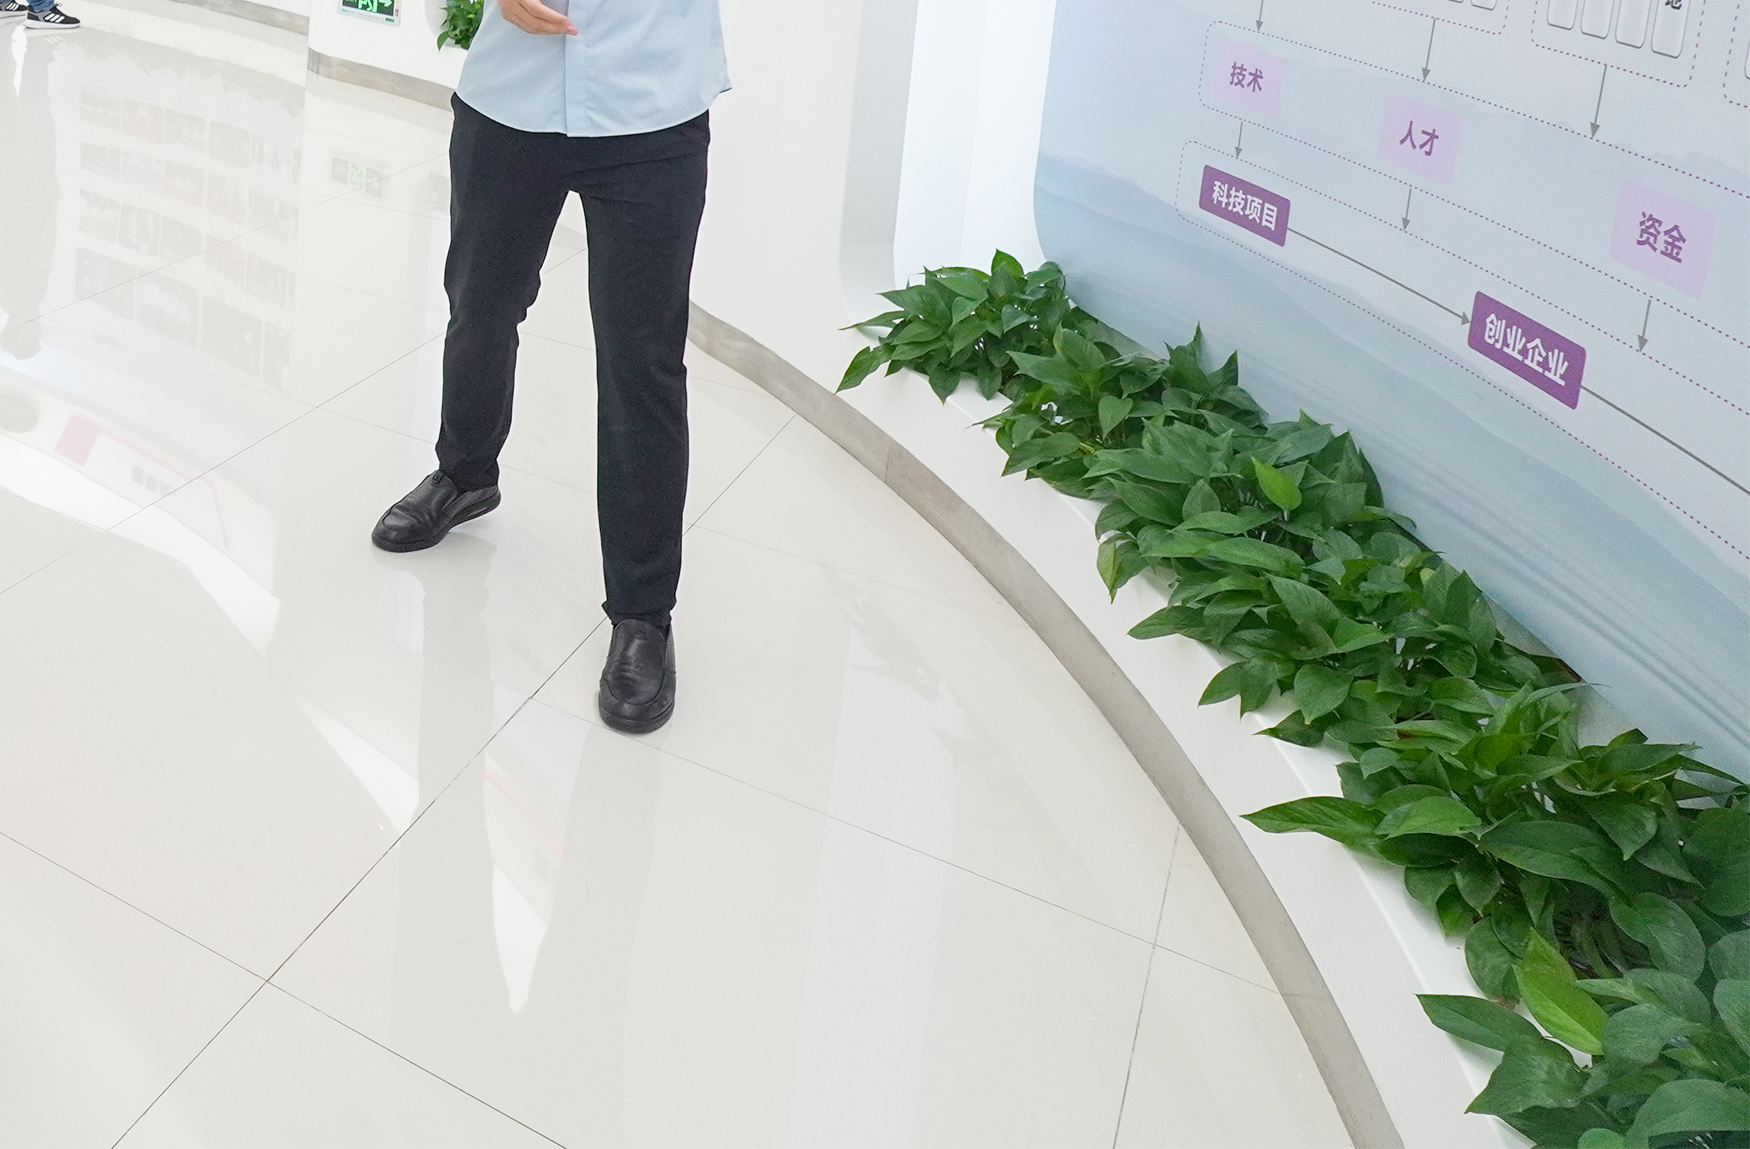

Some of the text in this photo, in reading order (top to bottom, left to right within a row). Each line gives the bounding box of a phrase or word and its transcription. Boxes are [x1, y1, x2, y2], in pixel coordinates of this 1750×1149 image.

[1229, 61, 1264, 94] 技术
[1398, 120, 1440, 158] 人才
[1211, 179, 1279, 232] 科技项目
[1636, 210, 1688, 264] 资金
[1483, 312, 1570, 387] 创业企业
